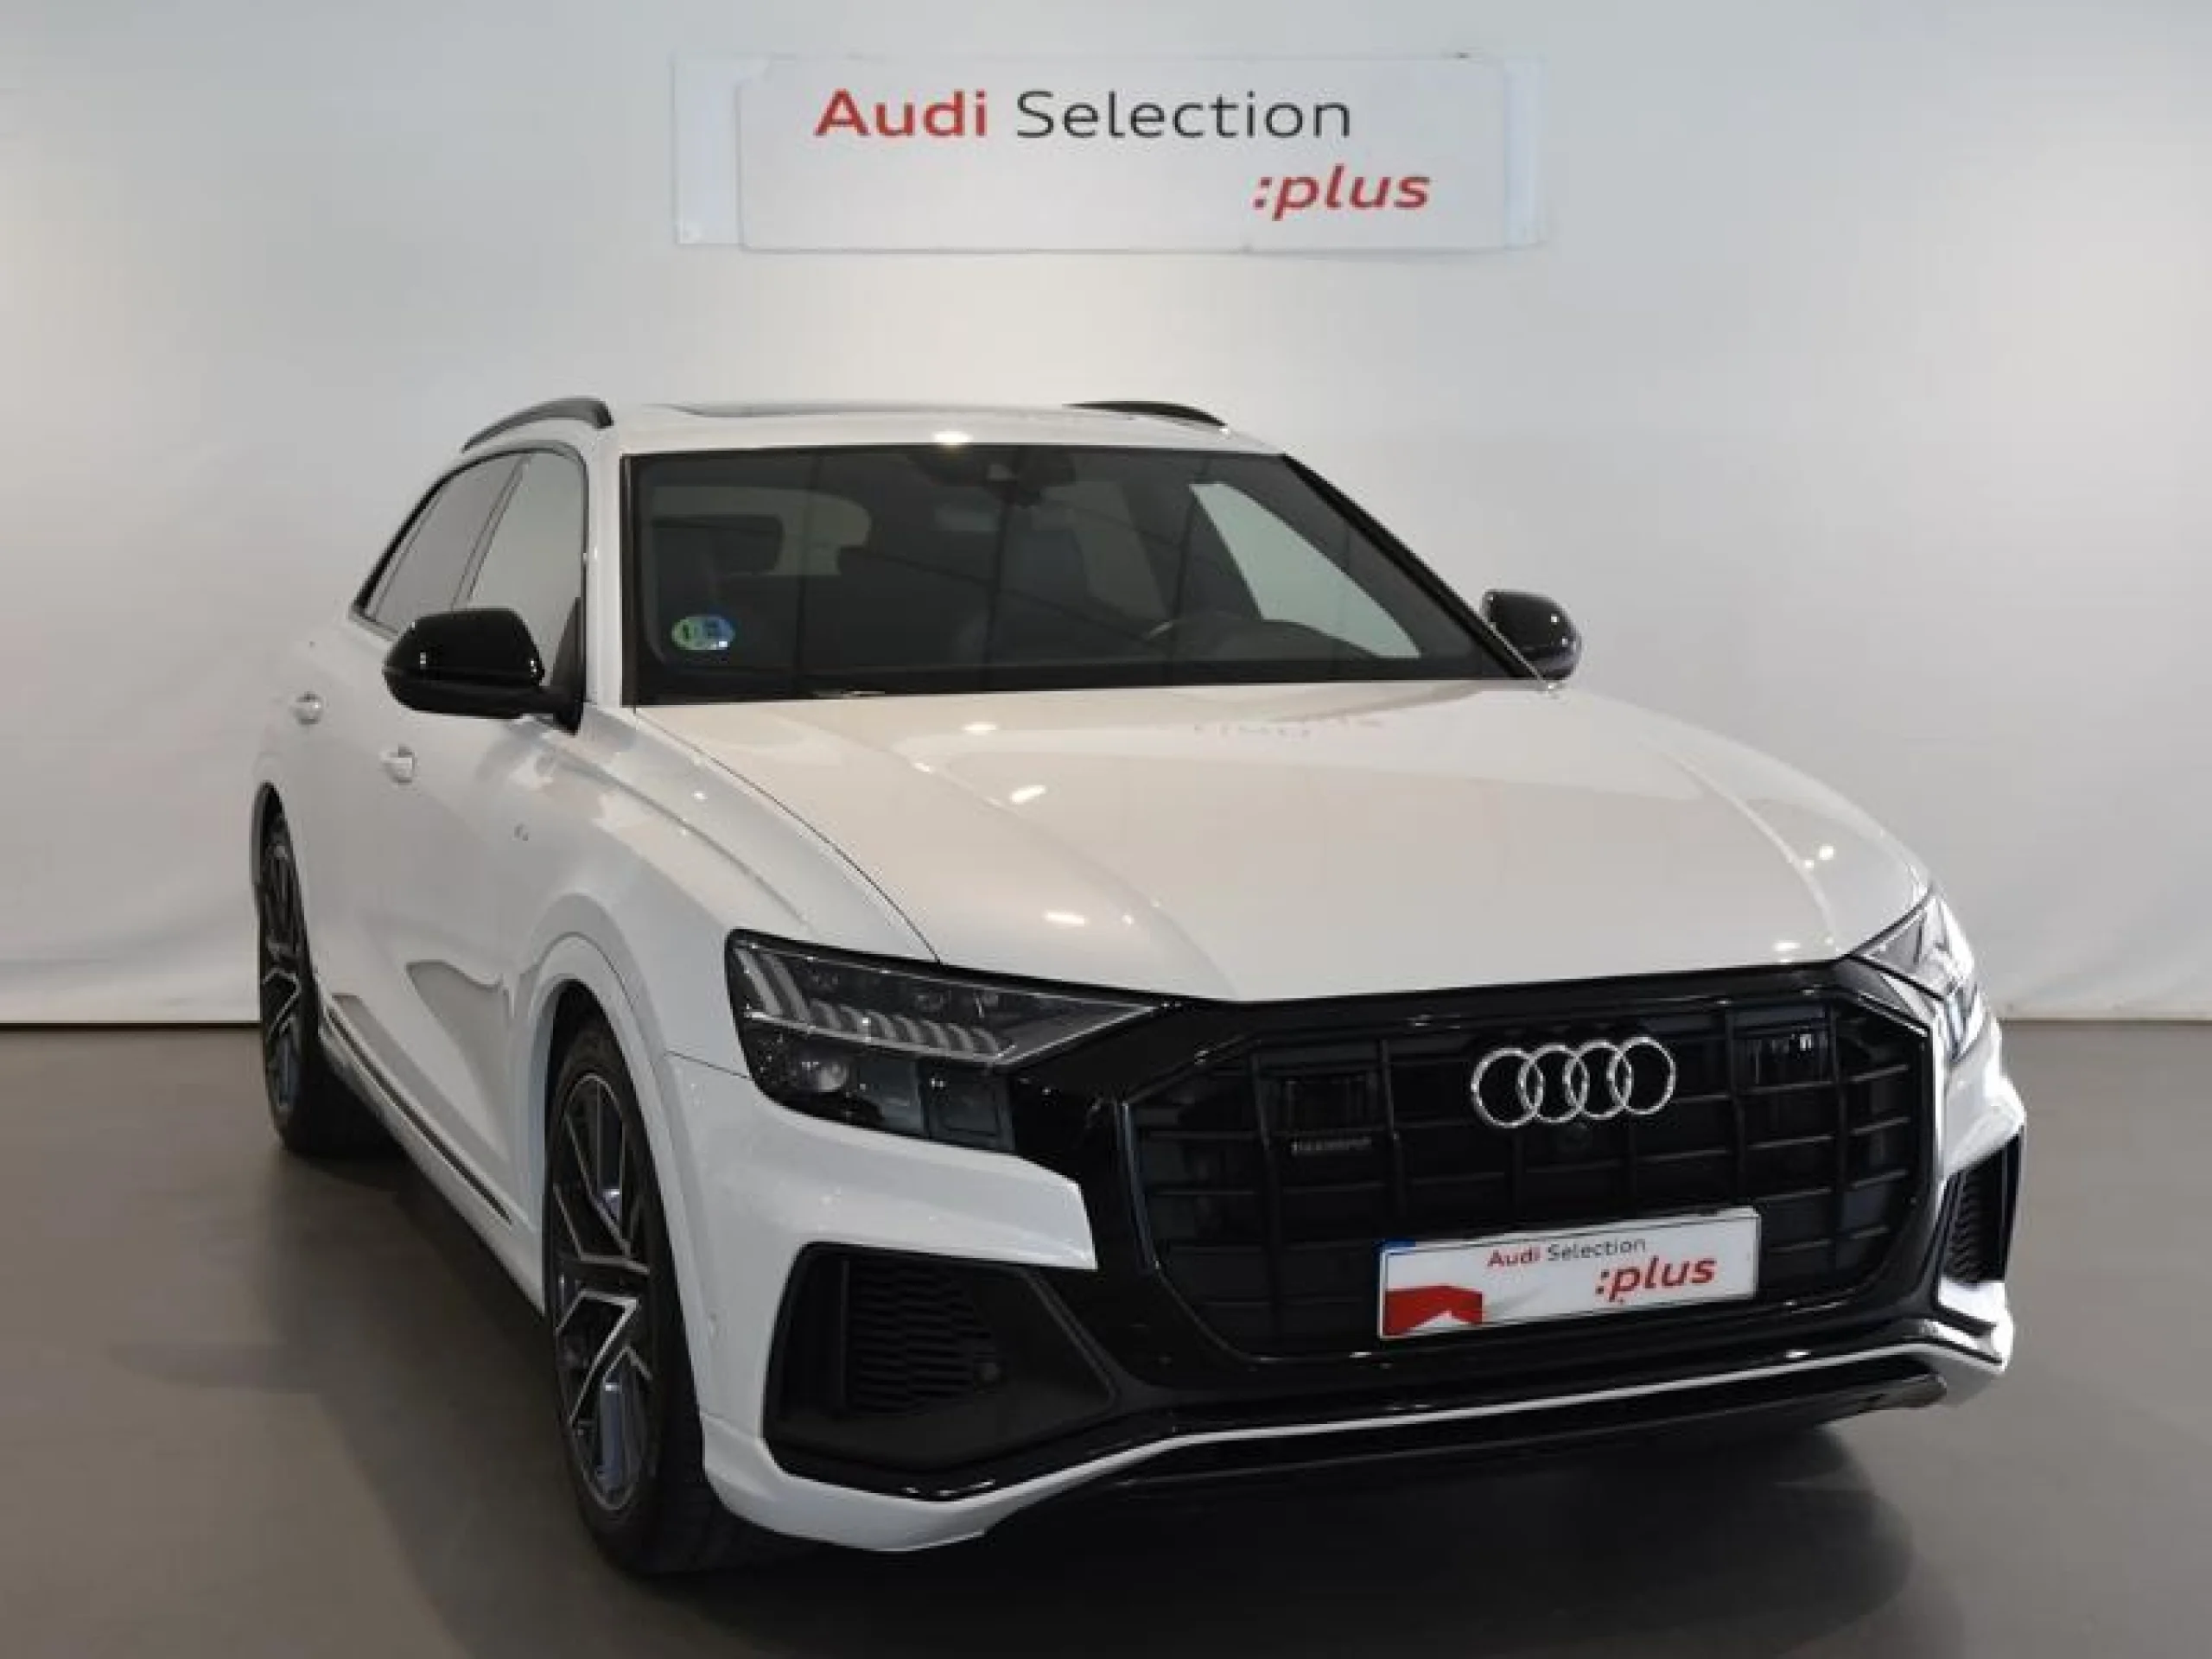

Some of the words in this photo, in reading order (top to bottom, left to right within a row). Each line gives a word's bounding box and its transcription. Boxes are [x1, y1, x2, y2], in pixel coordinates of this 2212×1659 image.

[814, 88, 988, 138] Audi
[1016, 89, 1351, 139] Selection
[1252, 163, 1431, 221] :plus
[1486, 1248, 1541, 1268] Audi
[1547, 1238, 1646, 1262] Selection
[1594, 1255, 1717, 1303] :plus
